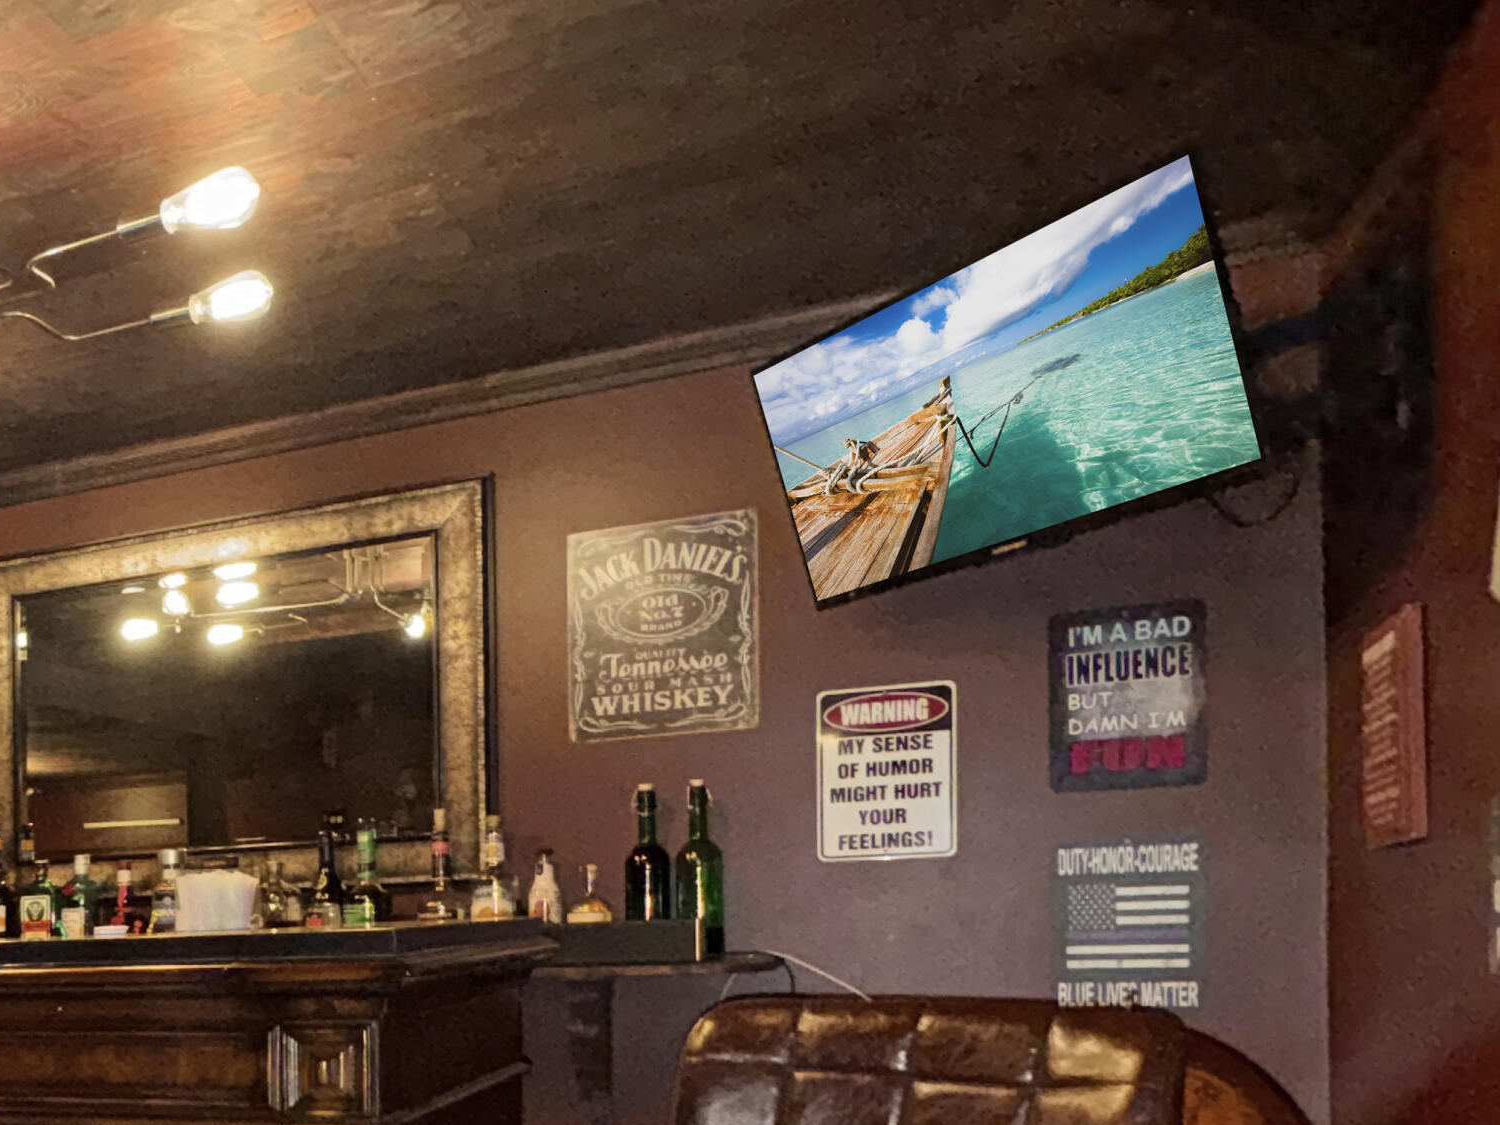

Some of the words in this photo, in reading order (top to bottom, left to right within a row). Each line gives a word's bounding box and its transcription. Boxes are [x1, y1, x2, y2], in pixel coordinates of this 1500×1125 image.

[578, 552, 641, 600] JACK
[643, 538, 747, 583] DANIEL'S
[624, 573, 653, 589] OLD
[657, 572, 693, 583] TIME
[1068, 625, 1103, 648] I'M
[1110, 622, 1127, 643] A
[1134, 616, 1192, 641] BAD
[635, 648, 687, 661] QUALITY
[1066, 642, 1193, 688] INFLUENCE
[599, 653, 729, 683] Tennessee
[596, 681, 656, 695] SOUR
[669, 672, 733, 688] MASH
[591, 684, 734, 717] WHISKEY
[839, 698, 930, 726] WARNING
[1068, 691, 1113, 711] BUT
[1068, 714, 1139, 736] DAMN
[1148, 710, 1187, 729] I'M
[838, 739, 865, 756] MY
[872, 734, 934, 753] SENSE
[1069, 734, 1187, 776] FUN
[838, 763, 860, 780] OF
[866, 758, 934, 778] HUMOR
[830, 785, 888, 803] MIGHT
[894, 781, 943, 800] HURT
[858, 808, 907, 825] YOUR
[838, 831, 934, 851] FEELINGS!
[1058, 981, 1095, 1007] BLUE
[1141, 981, 1199, 1007] MATTER
